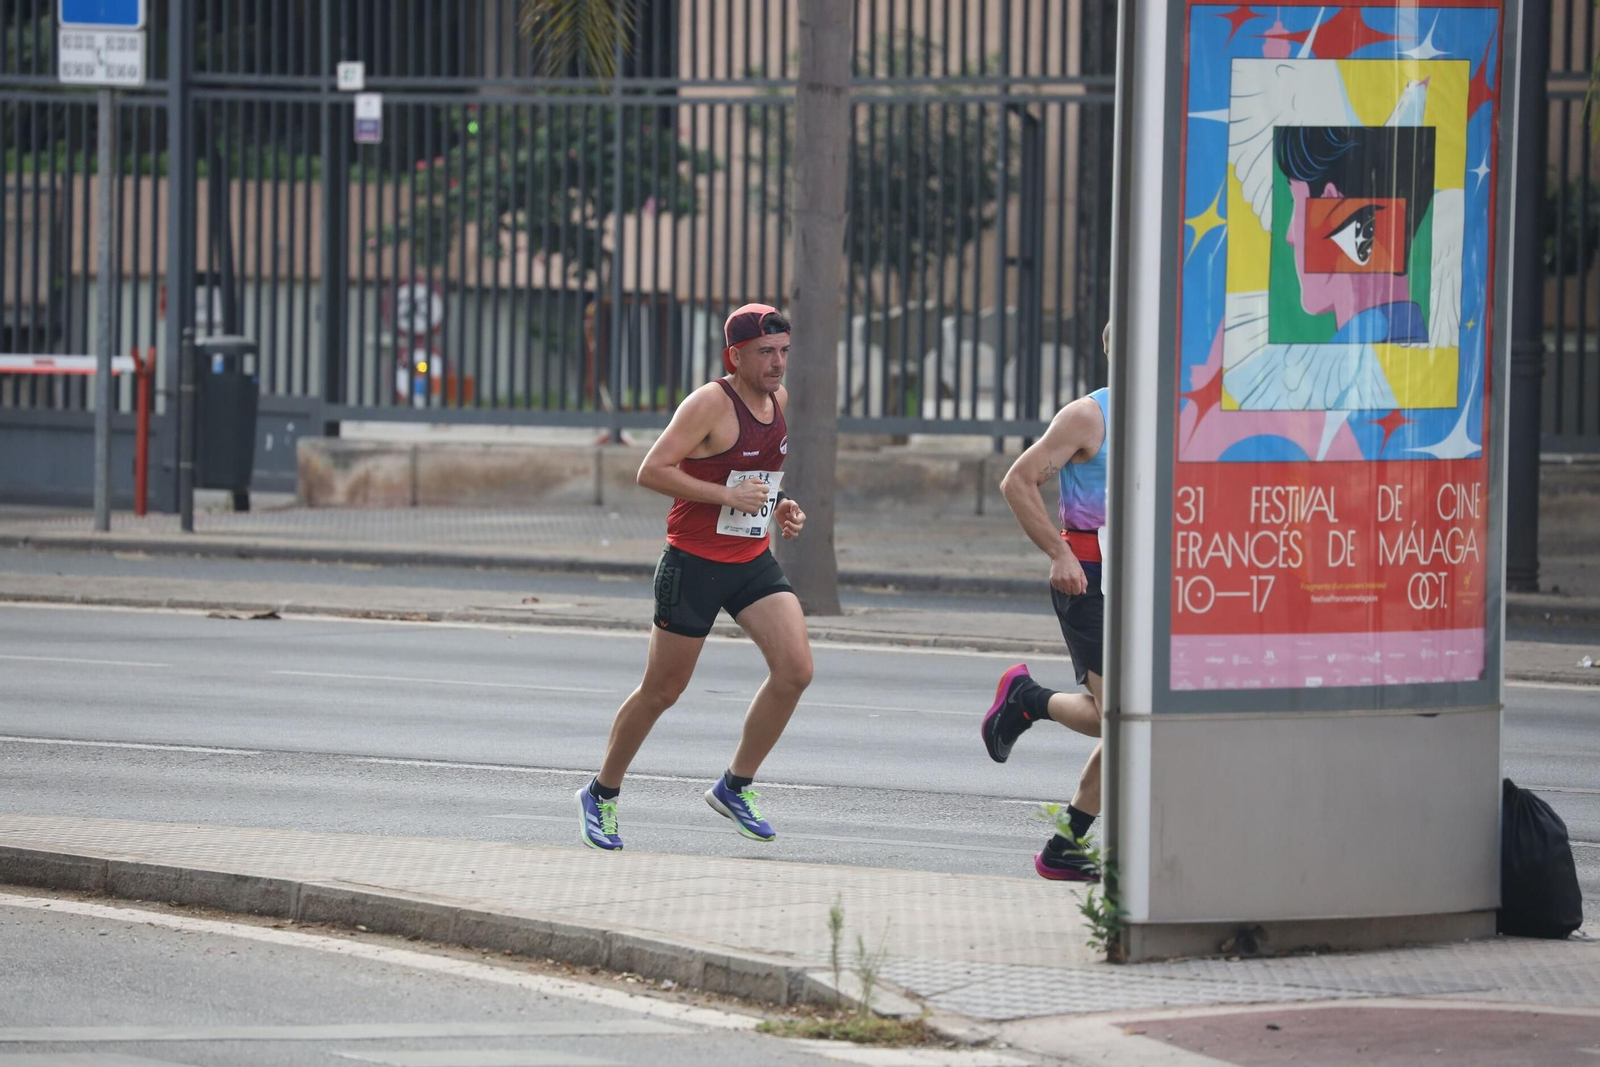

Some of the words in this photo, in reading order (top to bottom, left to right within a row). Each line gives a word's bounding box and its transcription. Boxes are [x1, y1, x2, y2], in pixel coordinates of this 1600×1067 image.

[1176, 486, 1204, 525] 31
[1250, 486, 1339, 524] FESTIVAL
[1378, 484, 1403, 522] DE
[1437, 482, 1481, 521] CINE
[1176, 522, 1303, 569] FRANCÉS
[1328, 529, 1357, 568] DE
[1379, 520, 1480, 566] MÁLAGA
[1408, 571, 1448, 610] OCT.
